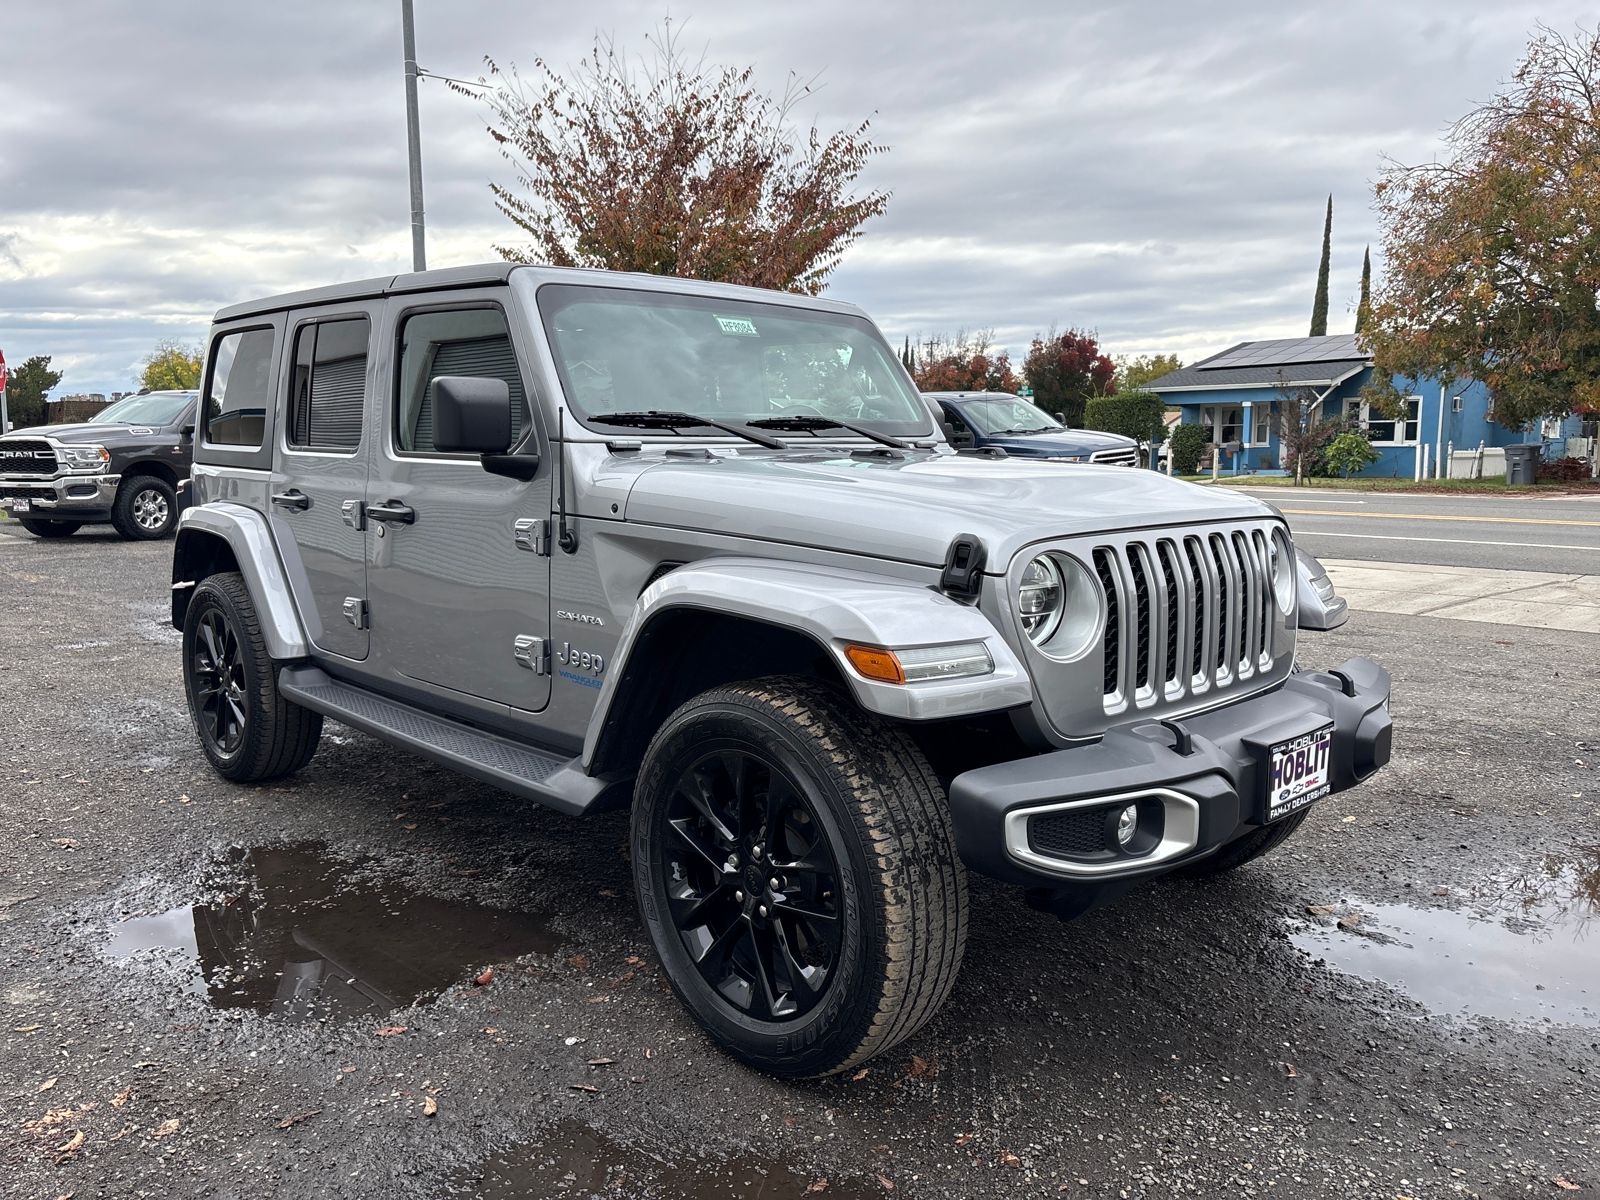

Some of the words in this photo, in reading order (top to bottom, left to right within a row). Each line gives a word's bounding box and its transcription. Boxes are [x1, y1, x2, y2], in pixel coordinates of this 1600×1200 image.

[557, 610, 604, 626] SAHARA
[556, 642, 604, 676] Jeep
[1289, 731, 1322, 751] HOBLIT
[1271, 740, 1329, 791] HOBLIT
[1305, 777, 1319, 788] GMC
[1270, 802, 1291, 819] FAMILY
[1292, 785, 1331, 809] DEALERSHIPS
